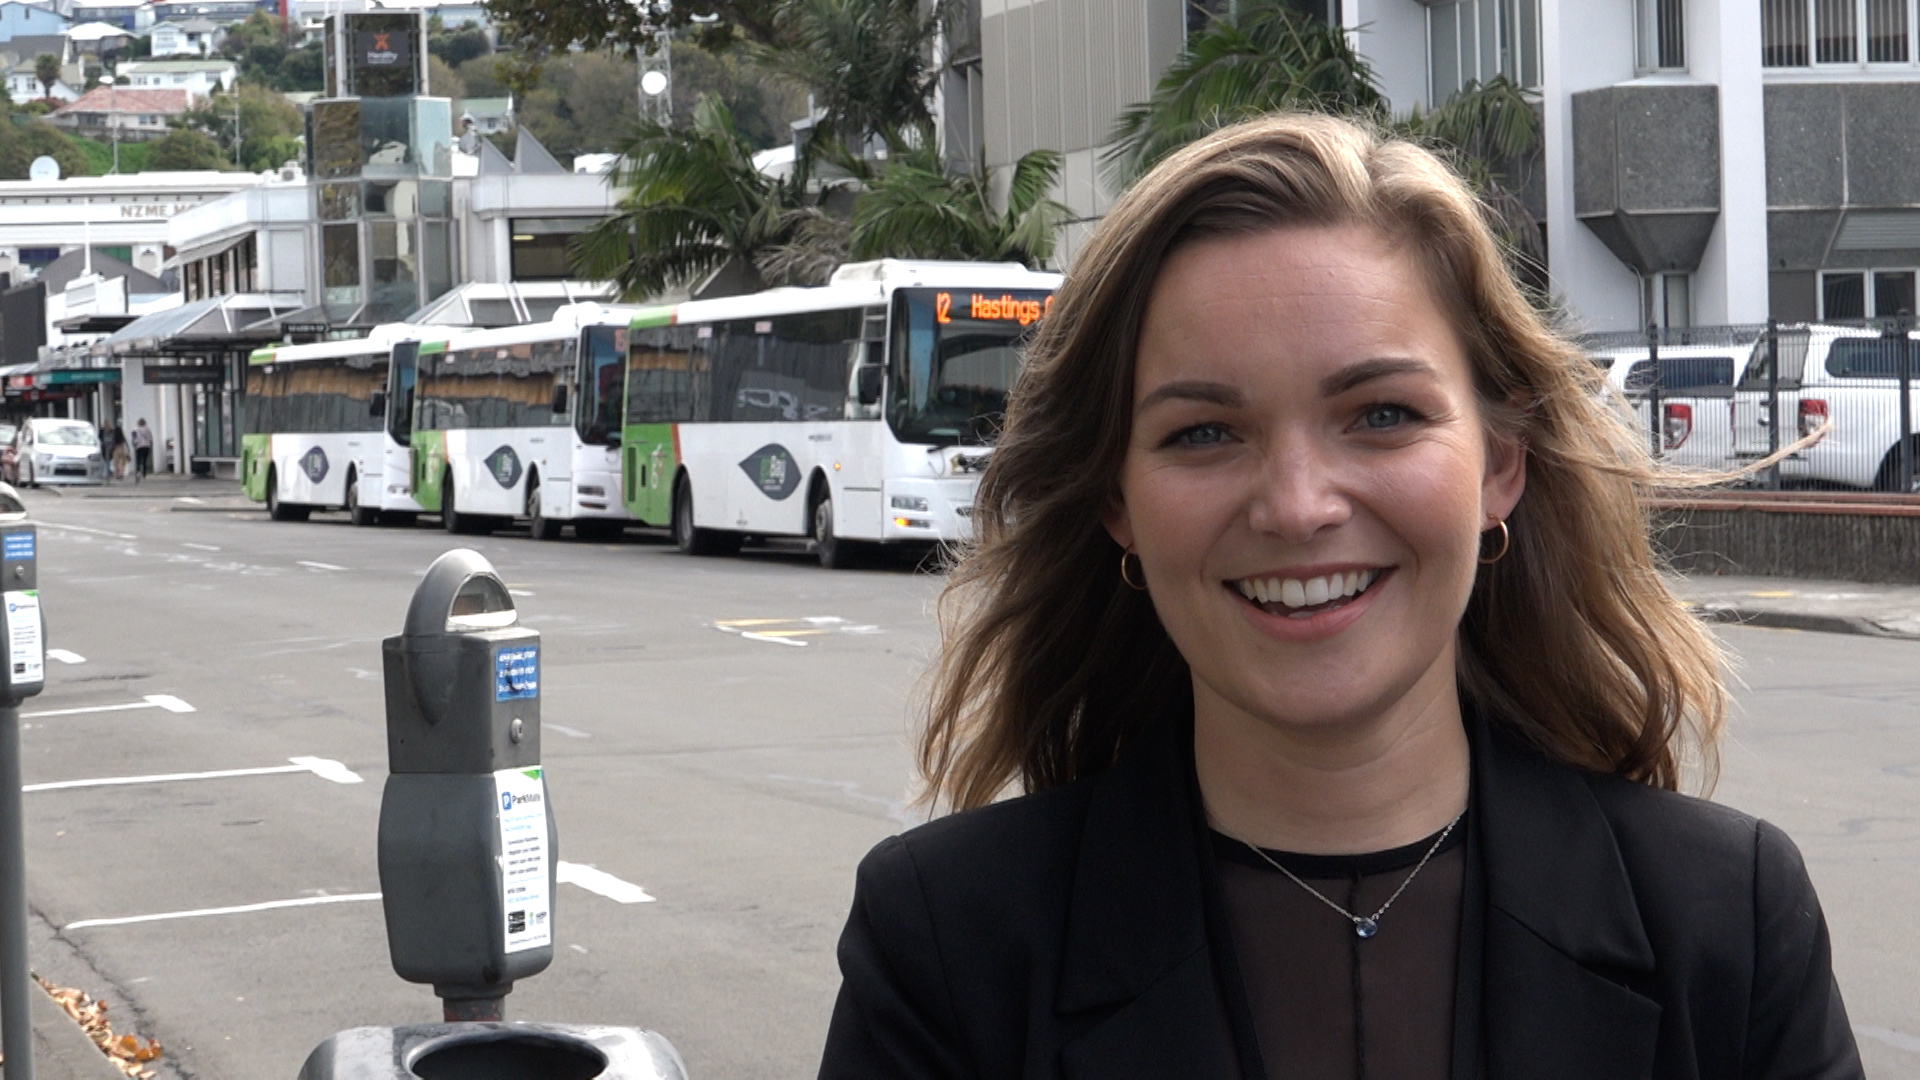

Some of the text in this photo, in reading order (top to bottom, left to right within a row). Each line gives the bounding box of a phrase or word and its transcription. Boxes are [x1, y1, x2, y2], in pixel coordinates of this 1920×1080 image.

[120, 205, 168, 218] NZME
[936, 292, 951, 324] 12
[971, 293, 1040, 326] Hastings
